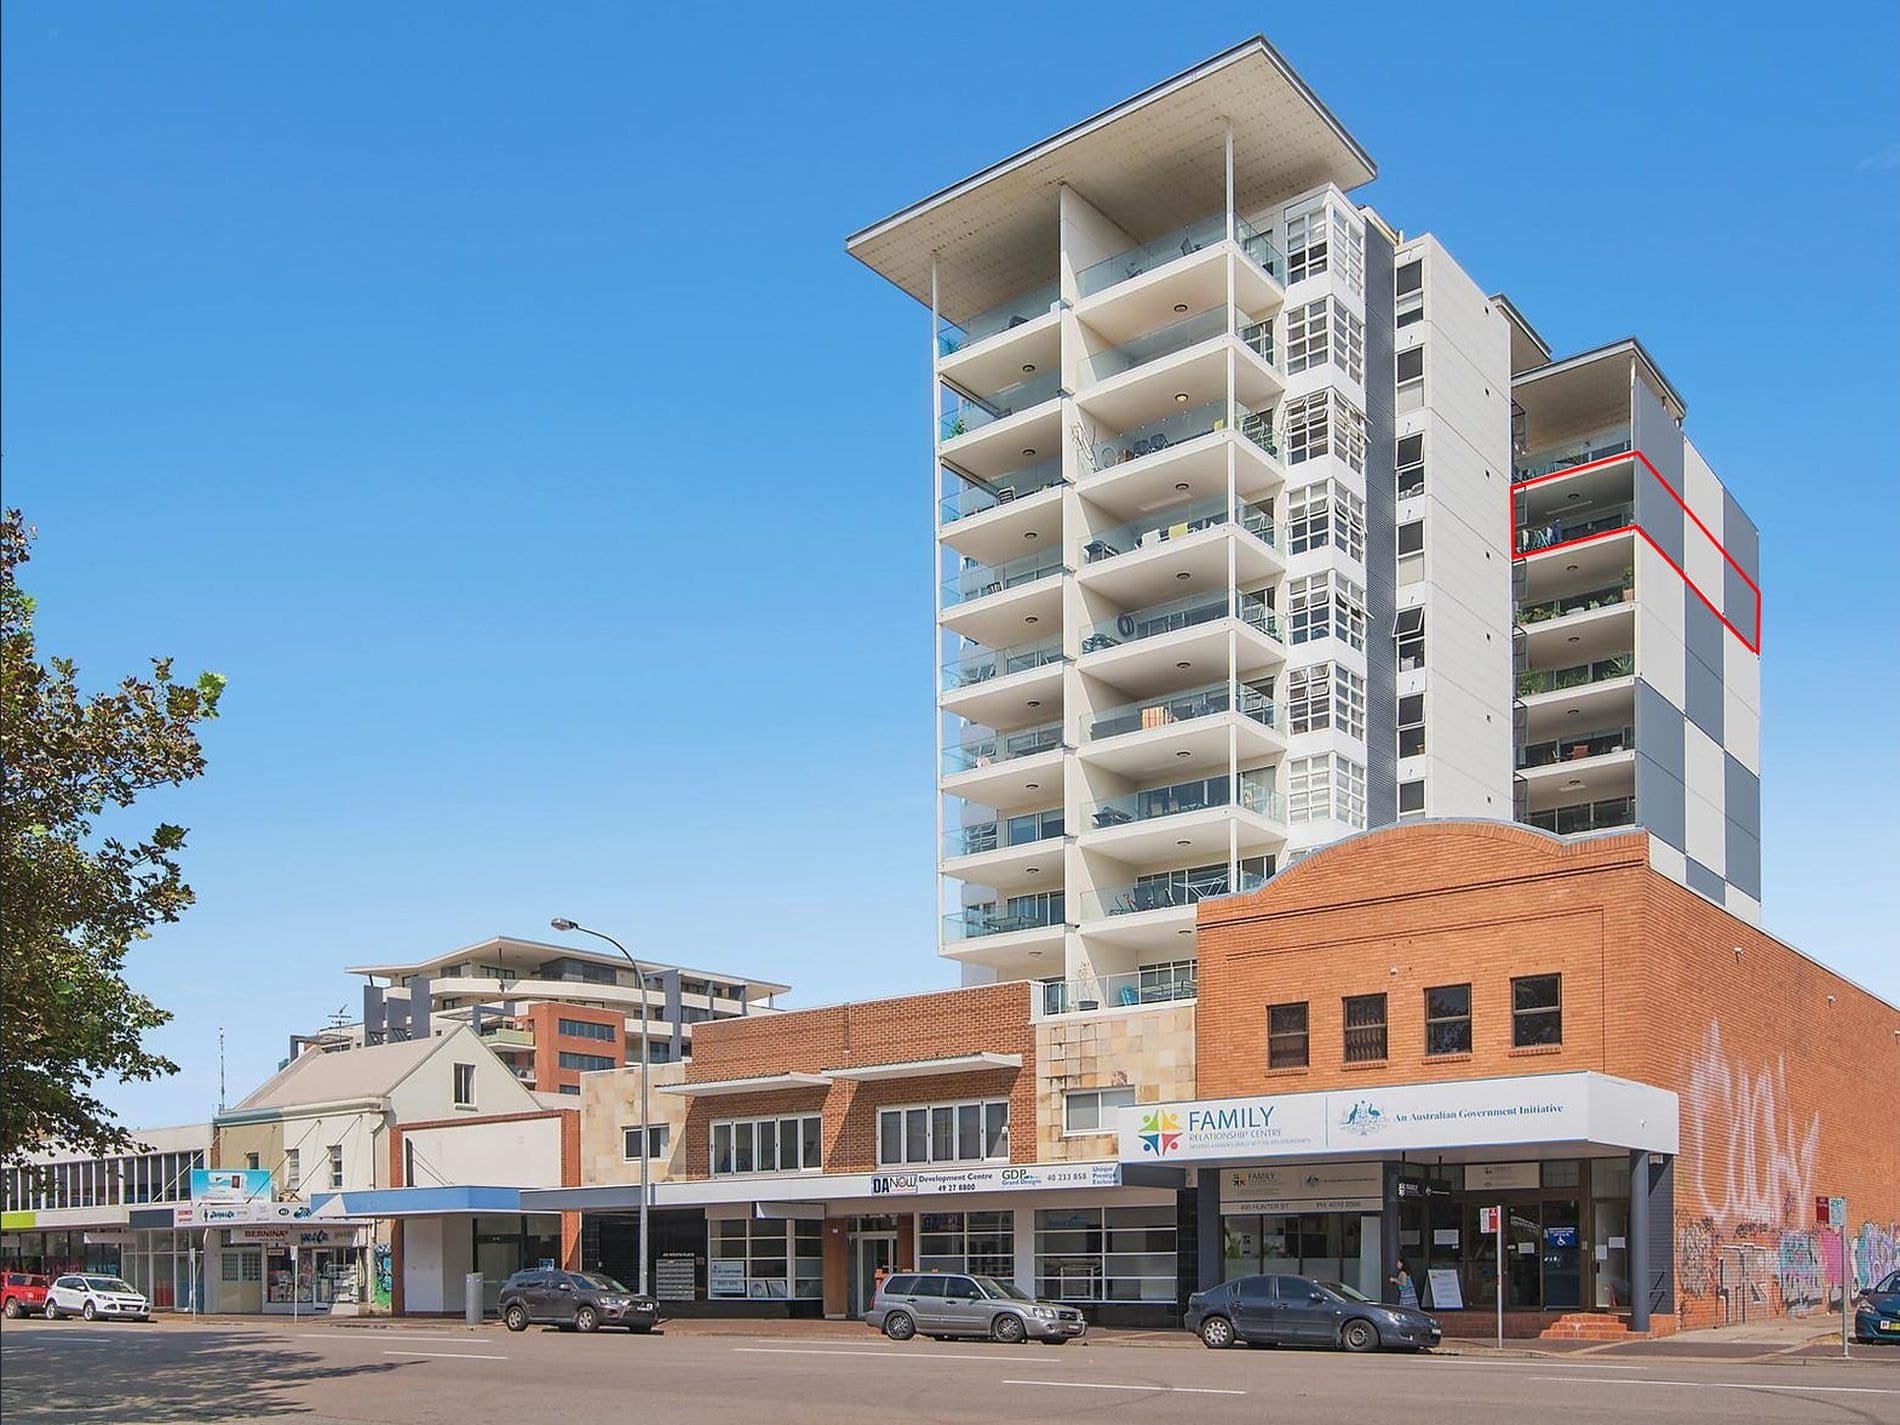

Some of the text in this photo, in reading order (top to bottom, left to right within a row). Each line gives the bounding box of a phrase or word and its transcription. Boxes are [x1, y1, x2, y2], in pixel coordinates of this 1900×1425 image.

[1189, 1105, 1275, 1131] FAMILY
[1394, 1103, 1564, 1122] An Australian Government Initiative
[1189, 1128, 1281, 1142] RELATIONSHIP CENTRE
[919, 1172, 993, 1184] Development Centre
[1001, 1169, 1027, 1180] GDP
[1248, 1172, 1275, 1180] FAMILY
[948, 1184, 957, 1192] 27
